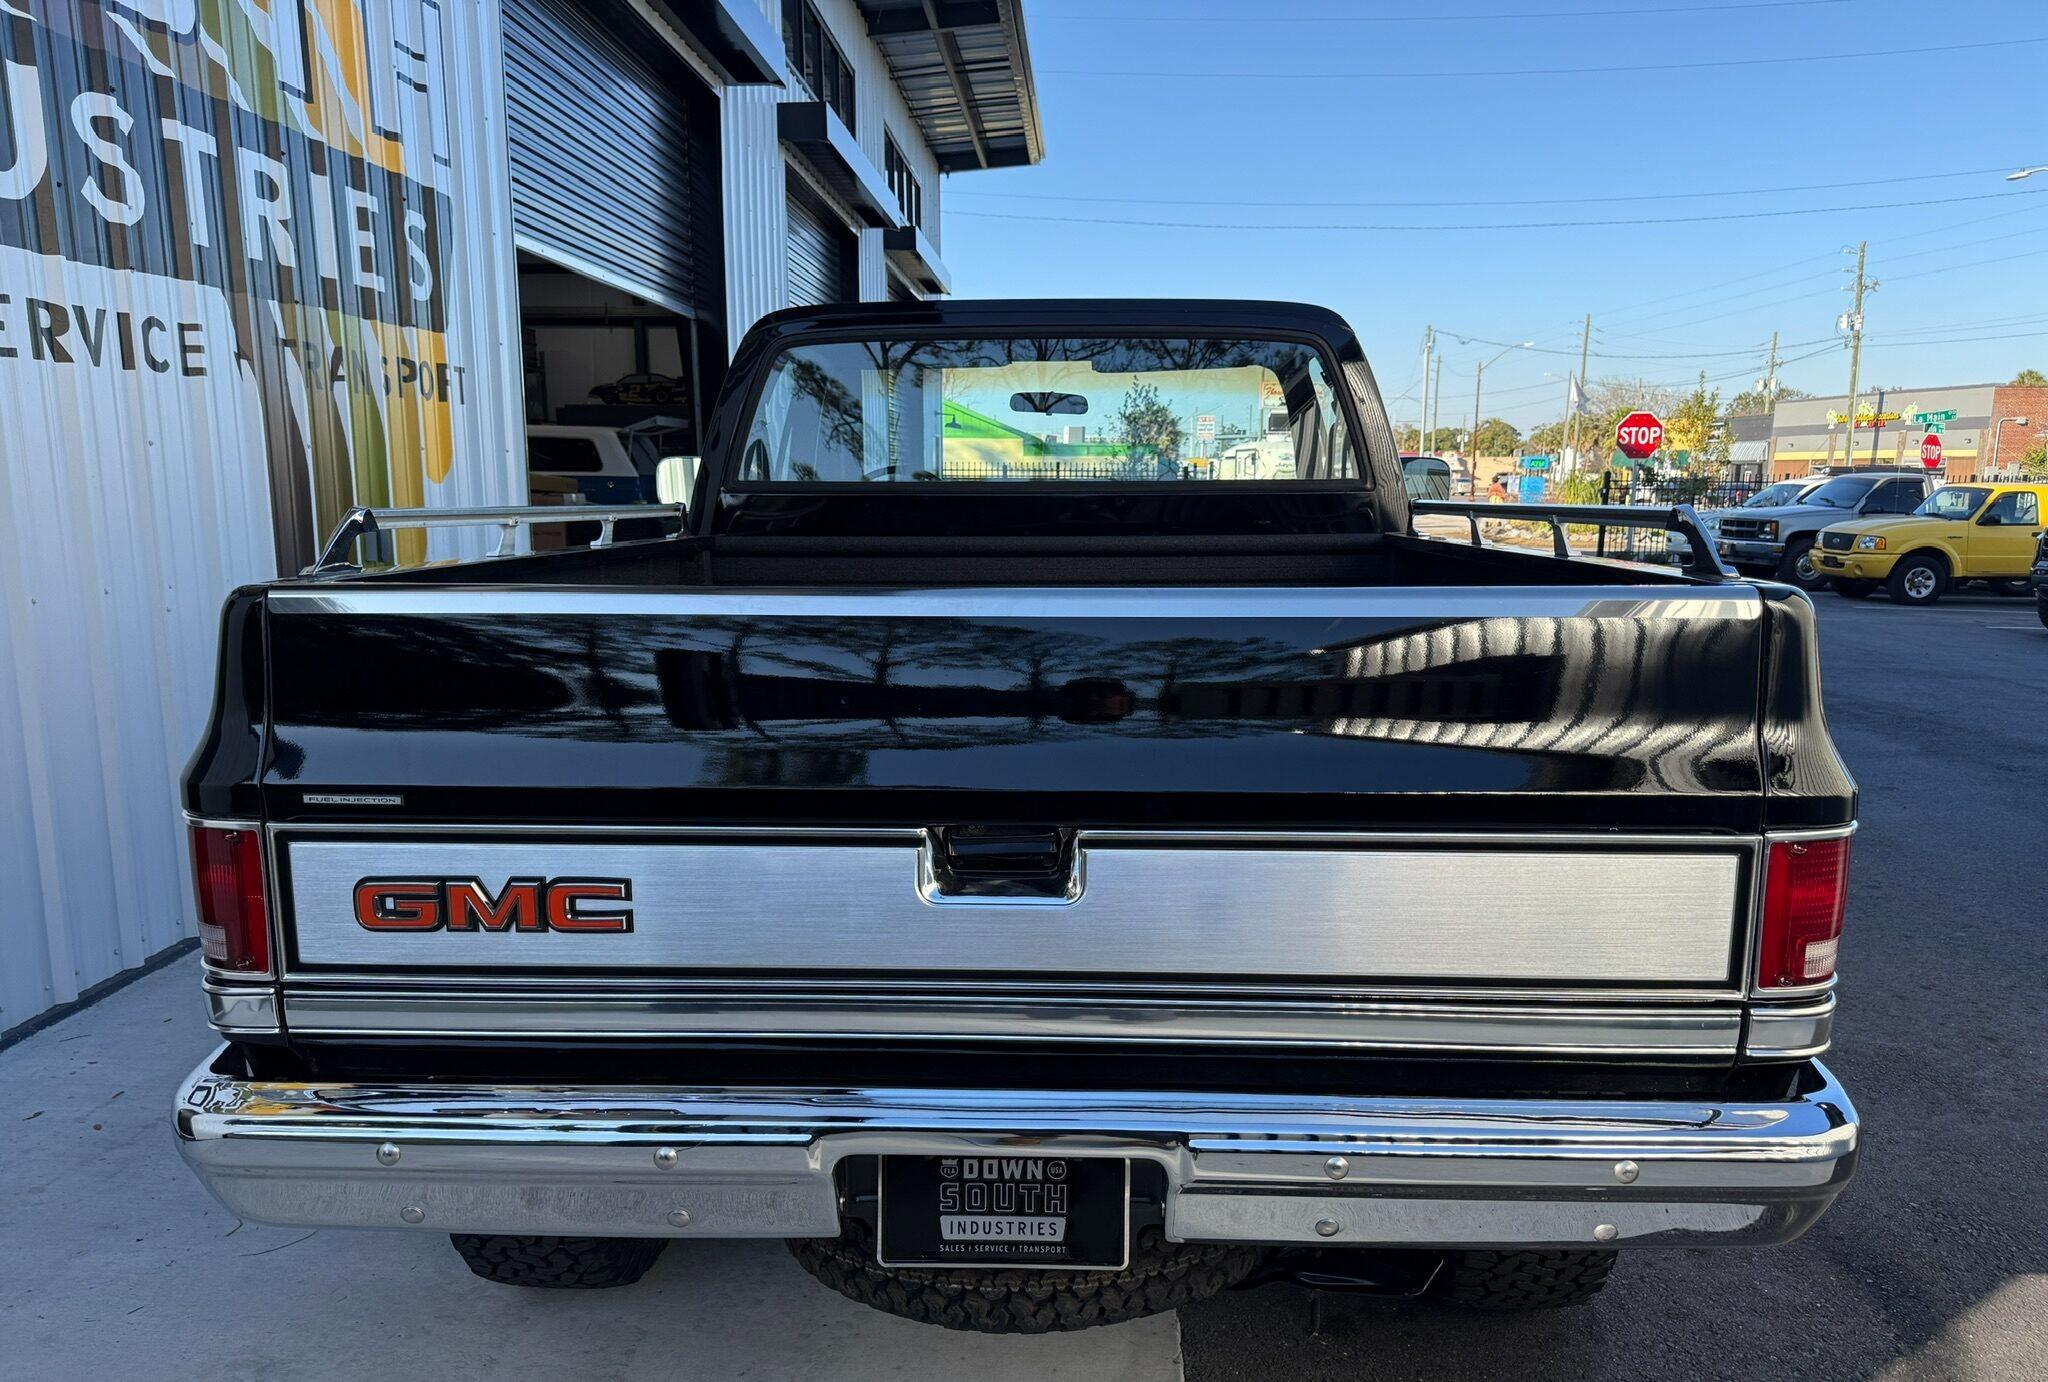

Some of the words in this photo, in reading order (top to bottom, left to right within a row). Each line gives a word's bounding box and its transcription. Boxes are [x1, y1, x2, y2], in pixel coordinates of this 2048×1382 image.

[1927, 412, 1945, 422] Main
[1619, 426, 1661, 445] STOP
[1921, 444, 1940, 459] STOP
[354, 875, 634, 933] GMC
[963, 1158, 1044, 1180] DOWN
[1050, 1166, 1063, 1174] USA
[939, 1183, 1067, 1213] SOUTH
[949, 1220, 1057, 1236] INDUSTRIES
[939, 1244, 965, 1252] SALES
[974, 1244, 1009, 1253] SERVICE
[1019, 1245, 1066, 1254] TRANSPORT
